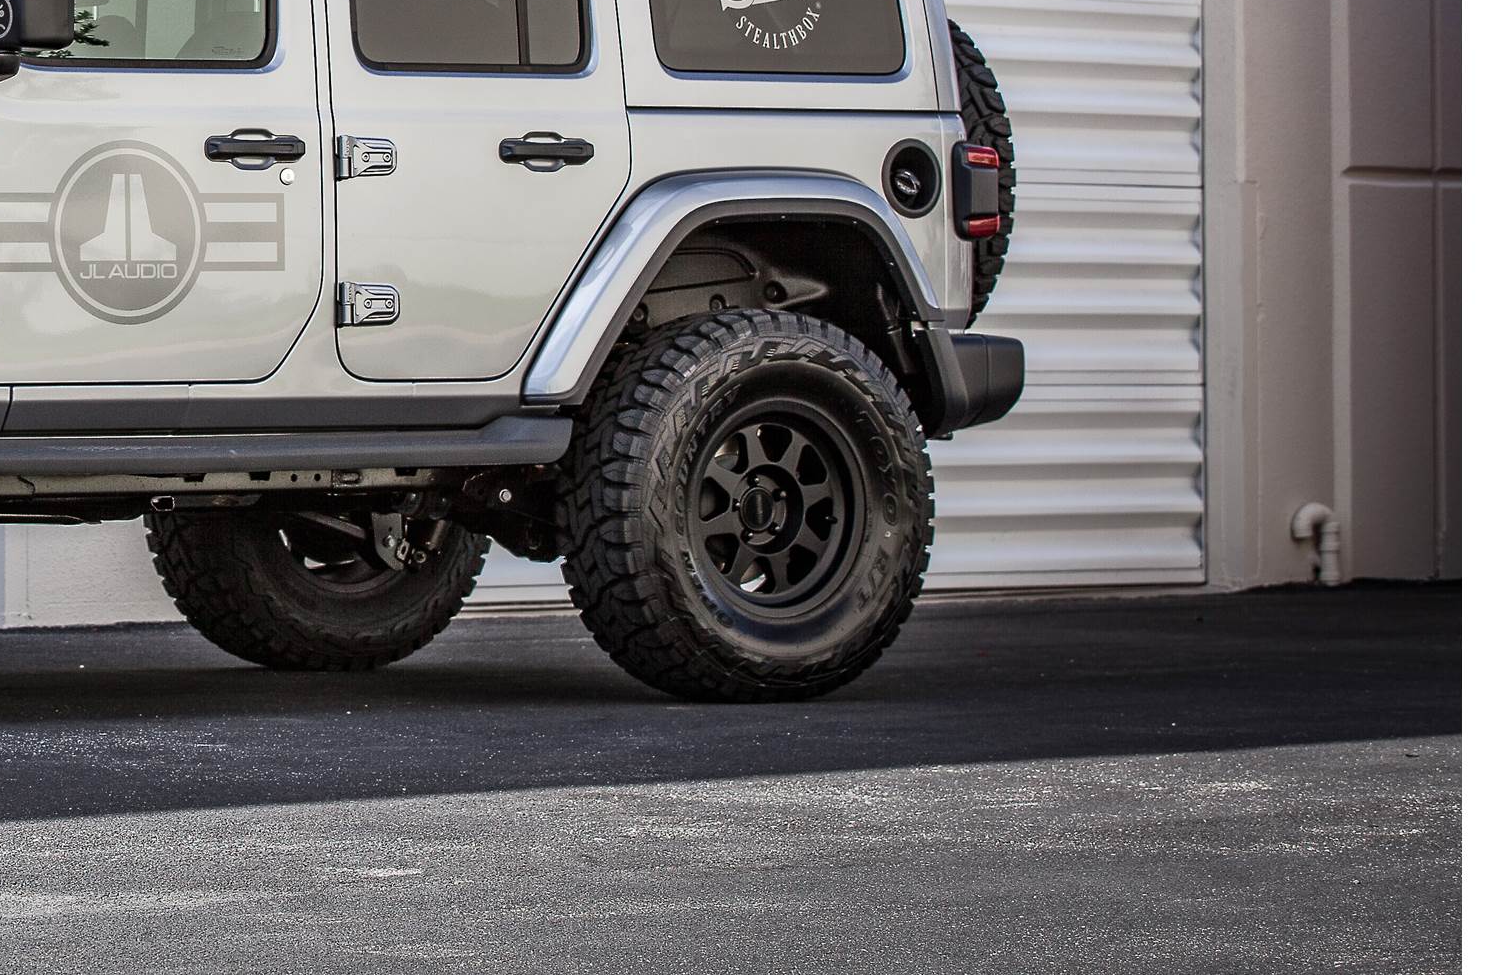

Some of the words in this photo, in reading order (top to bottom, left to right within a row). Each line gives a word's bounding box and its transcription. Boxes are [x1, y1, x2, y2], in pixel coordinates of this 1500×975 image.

[735, 7, 820, 50] STEALTHBOX
[80, 263, 106, 279] JL
[109, 263, 177, 279] AUDIO
